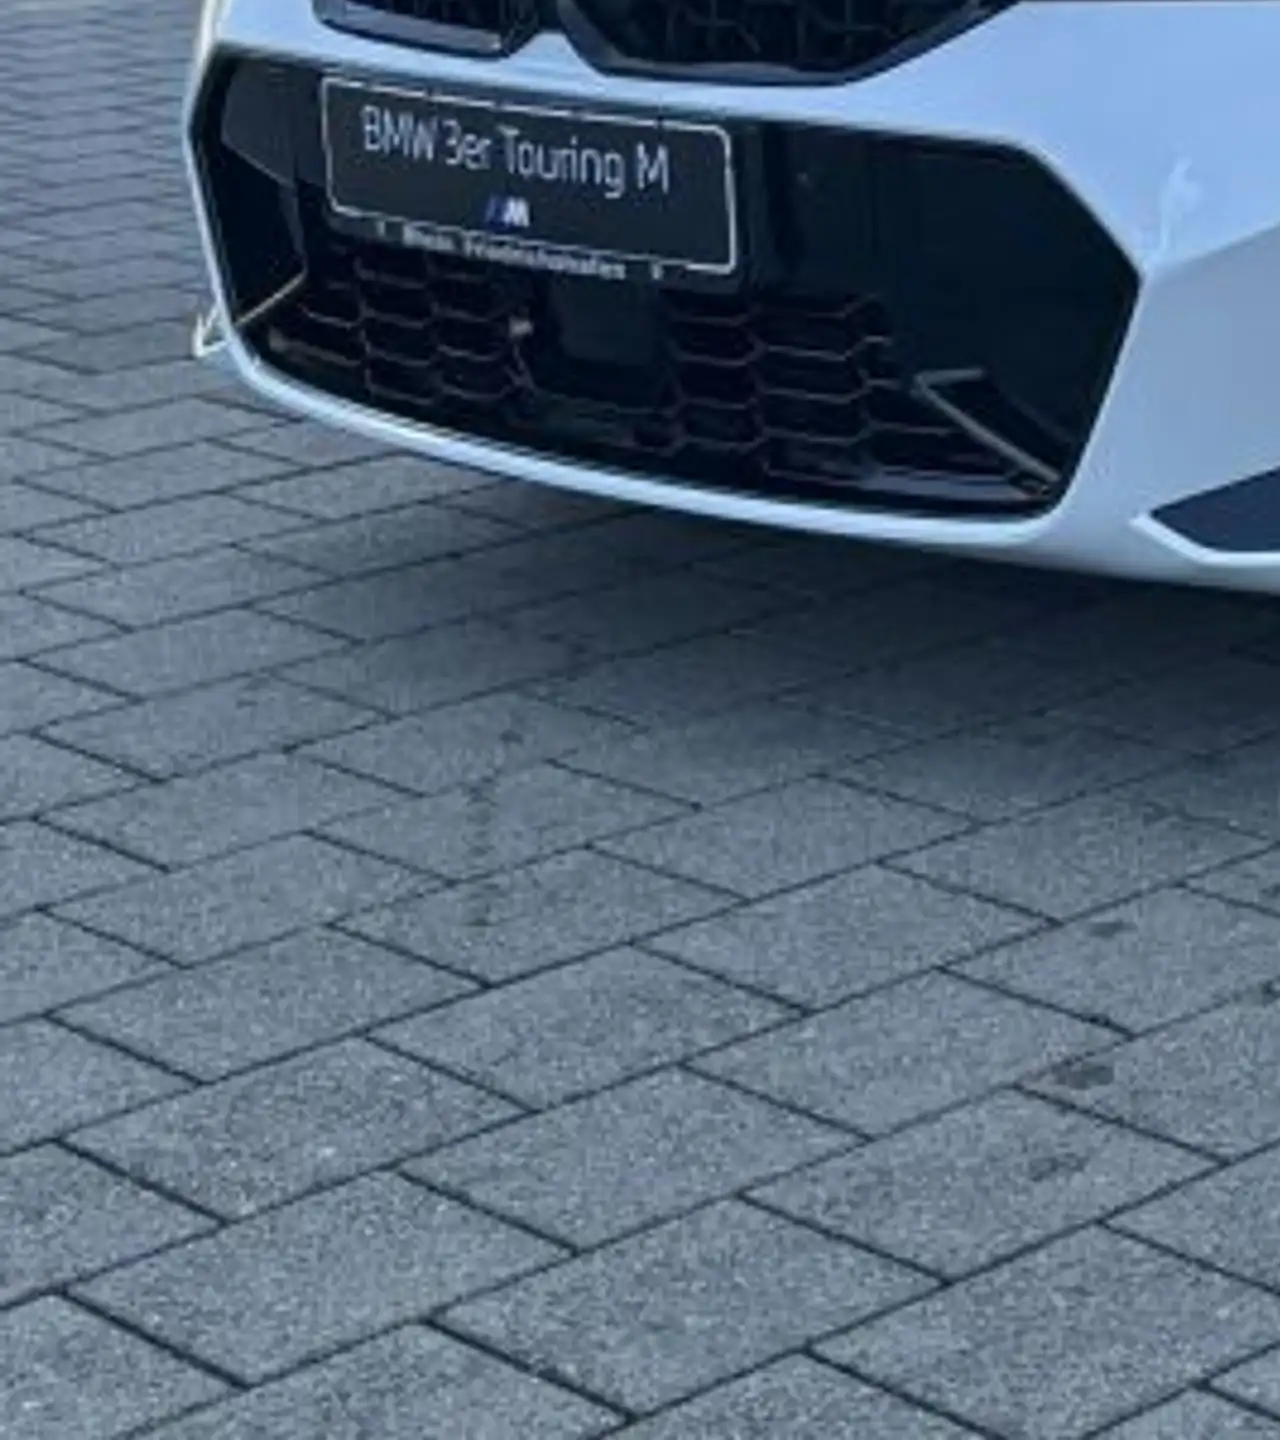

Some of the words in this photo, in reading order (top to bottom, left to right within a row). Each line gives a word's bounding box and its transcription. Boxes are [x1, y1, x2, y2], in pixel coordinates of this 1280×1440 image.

[362, 104, 435, 161] BMW
[444, 120, 492, 171] 3er
[501, 127, 626, 198] Touring
[636, 142, 670, 194] M
